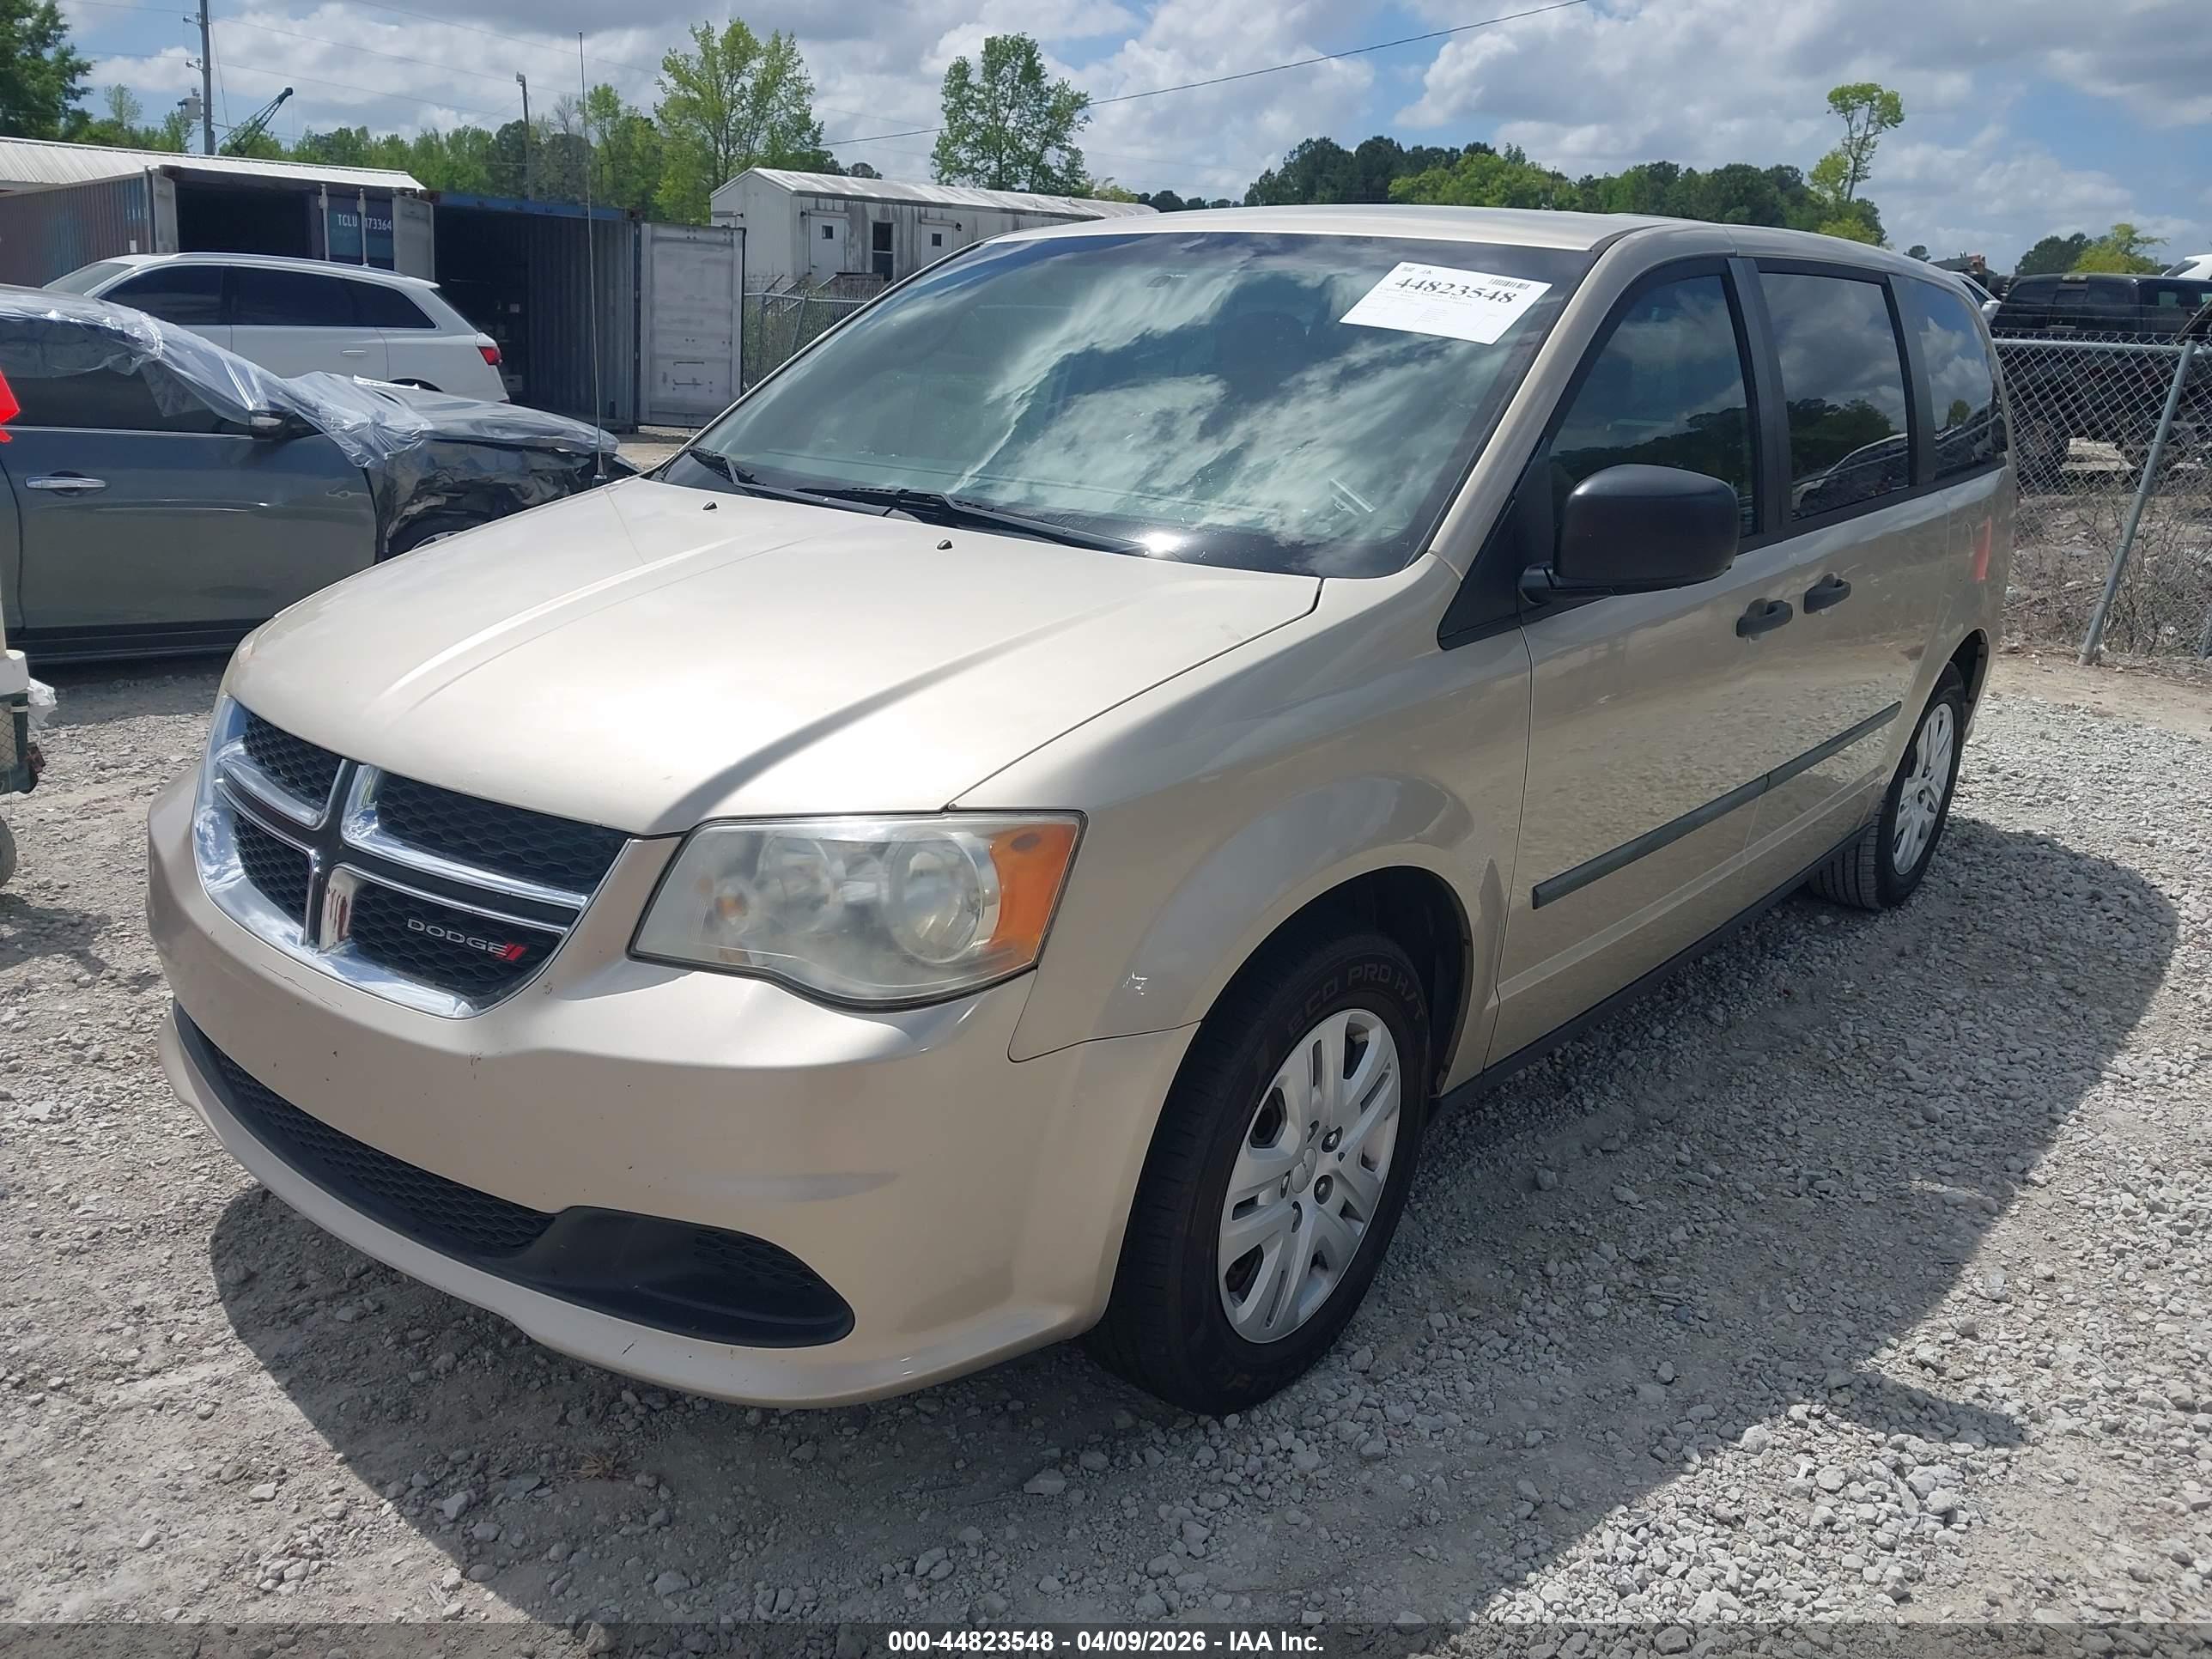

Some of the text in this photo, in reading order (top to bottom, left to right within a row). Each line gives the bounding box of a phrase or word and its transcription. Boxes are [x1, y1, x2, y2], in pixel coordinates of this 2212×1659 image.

[337, 214, 358, 228] TCLU
[1394, 277, 1518, 304] 44823548
[407, 918, 508, 957] DODGE
[1287, 976, 1339, 1037] ECO
[1347, 963, 1392, 987] PRO
